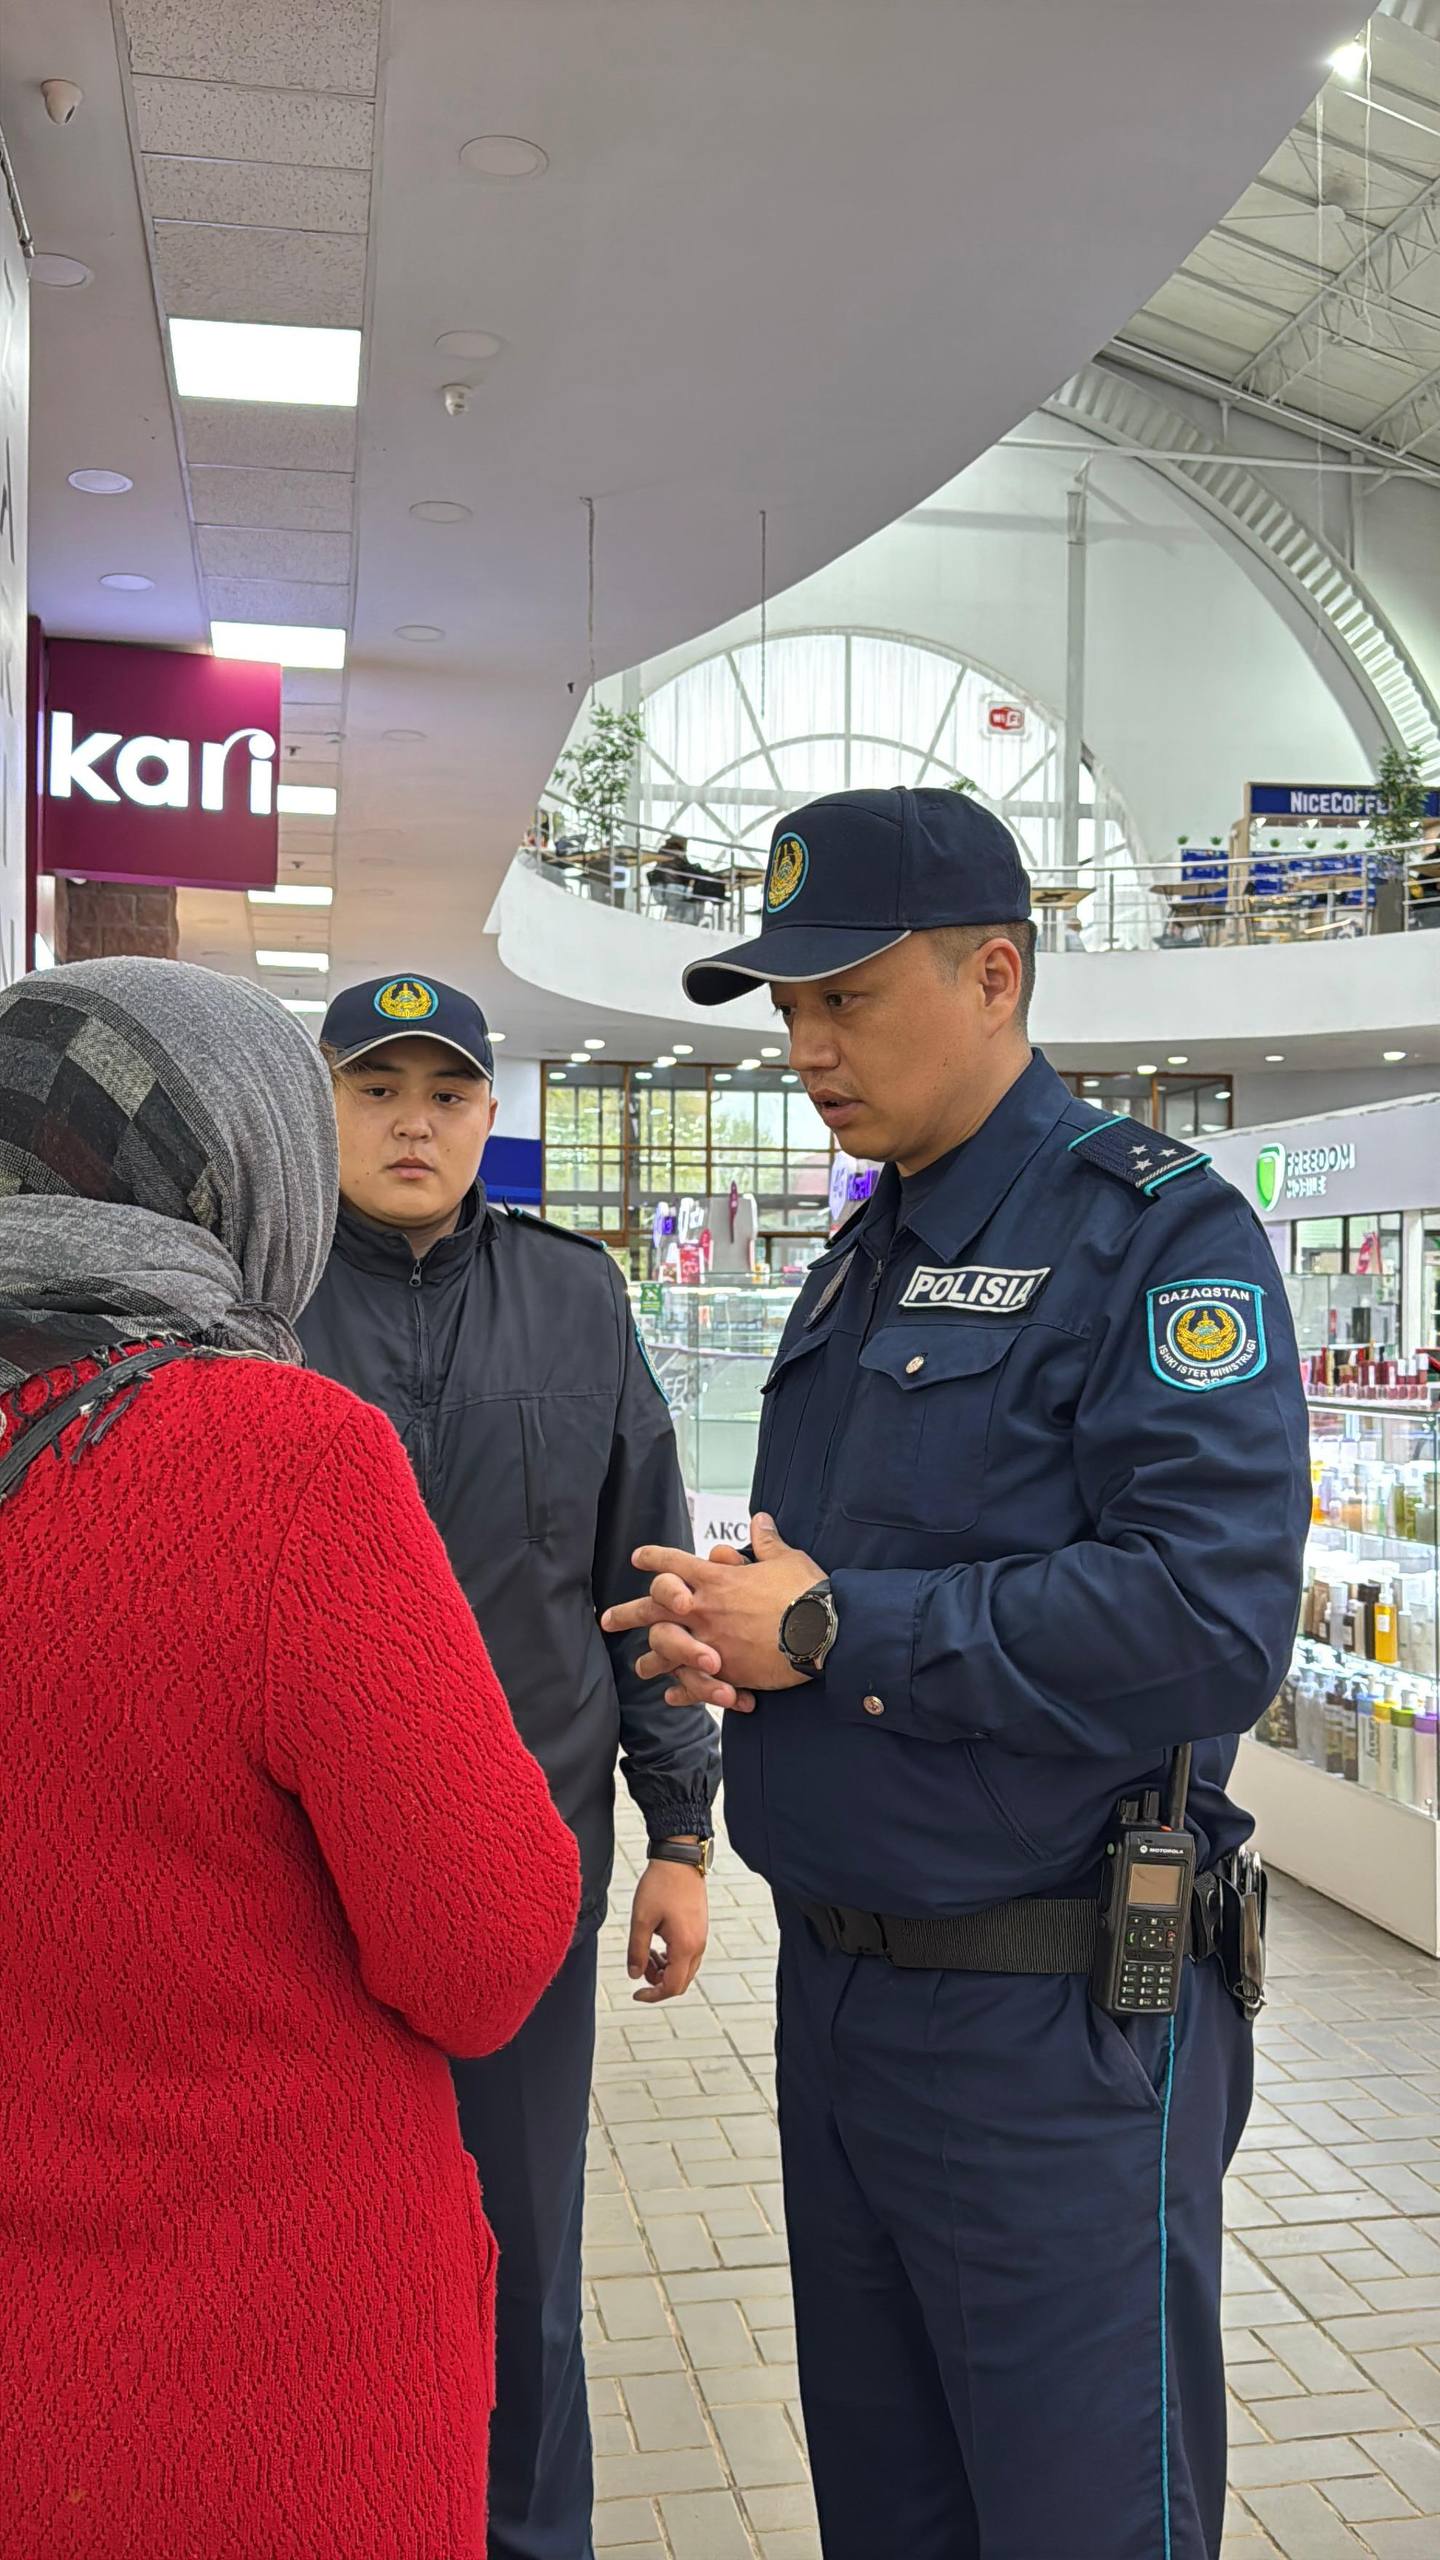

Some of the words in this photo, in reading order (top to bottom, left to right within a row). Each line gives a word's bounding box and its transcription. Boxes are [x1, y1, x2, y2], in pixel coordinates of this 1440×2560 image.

[50, 710, 276, 815] kari
[1286, 1143, 1356, 1176] FREEDOM
[908, 1273, 1036, 1306] POLISIA
[1159, 1287, 1250, 1305] QAZAQSTAN
[1158, 1344, 1179, 1369] ISHKI
[1176, 1364, 1208, 1378] ISTER
